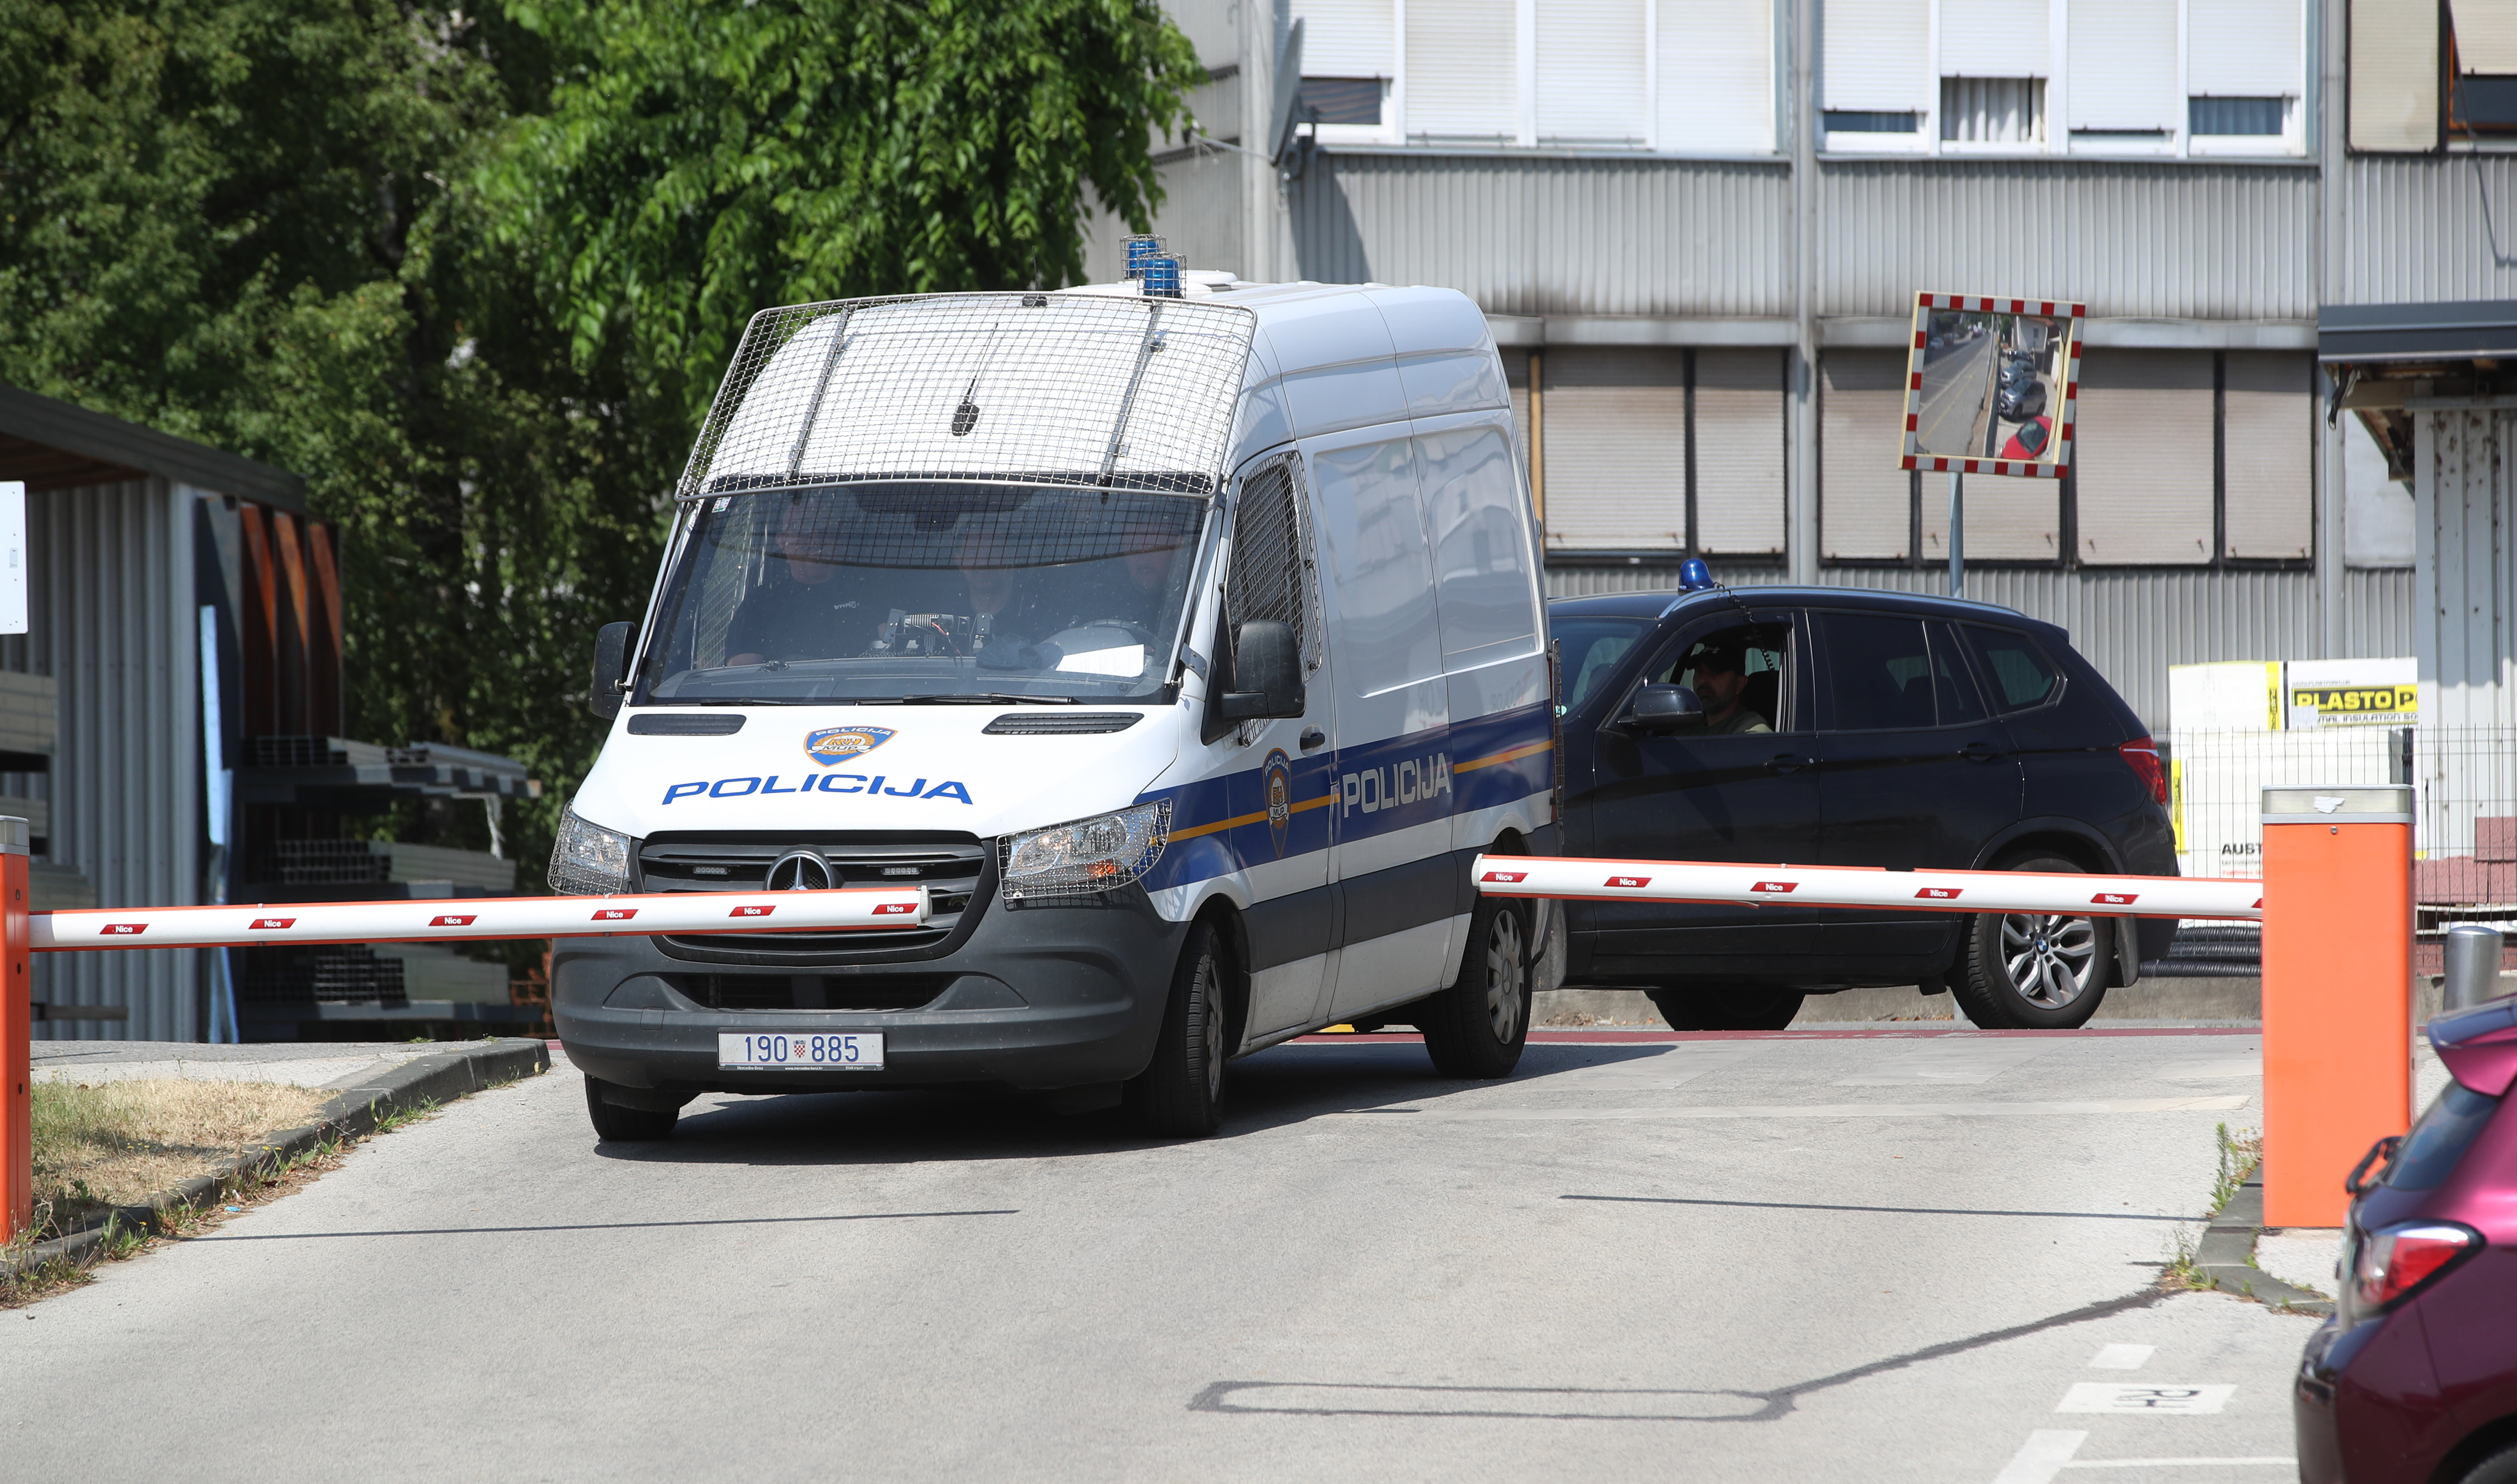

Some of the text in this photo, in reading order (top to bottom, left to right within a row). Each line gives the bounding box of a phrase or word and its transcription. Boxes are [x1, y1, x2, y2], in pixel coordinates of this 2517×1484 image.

[2297, 691, 2392, 710] PLASTO
[2343, 713, 2400, 723] INSULATION
[815, 727, 892, 736] POLICIJA
[1264, 755, 1289, 777] POLICIJA
[661, 774, 973, 804] POLICIJA
[1342, 752, 1451, 818] POLICIJA
[1273, 807, 1284, 817] MUP
[2222, 843, 2263, 854] AUST
[1619, 878, 1637, 886] Nice
[1765, 883, 1784, 891] Nice
[1930, 889, 1949, 897] Nice
[2105, 894, 2125, 903] Nice
[744, 907, 761, 915] Nice
[887, 904, 904, 913] Nice
[444, 916, 462, 925] Nice
[745, 1035, 859, 1062] 190 885
